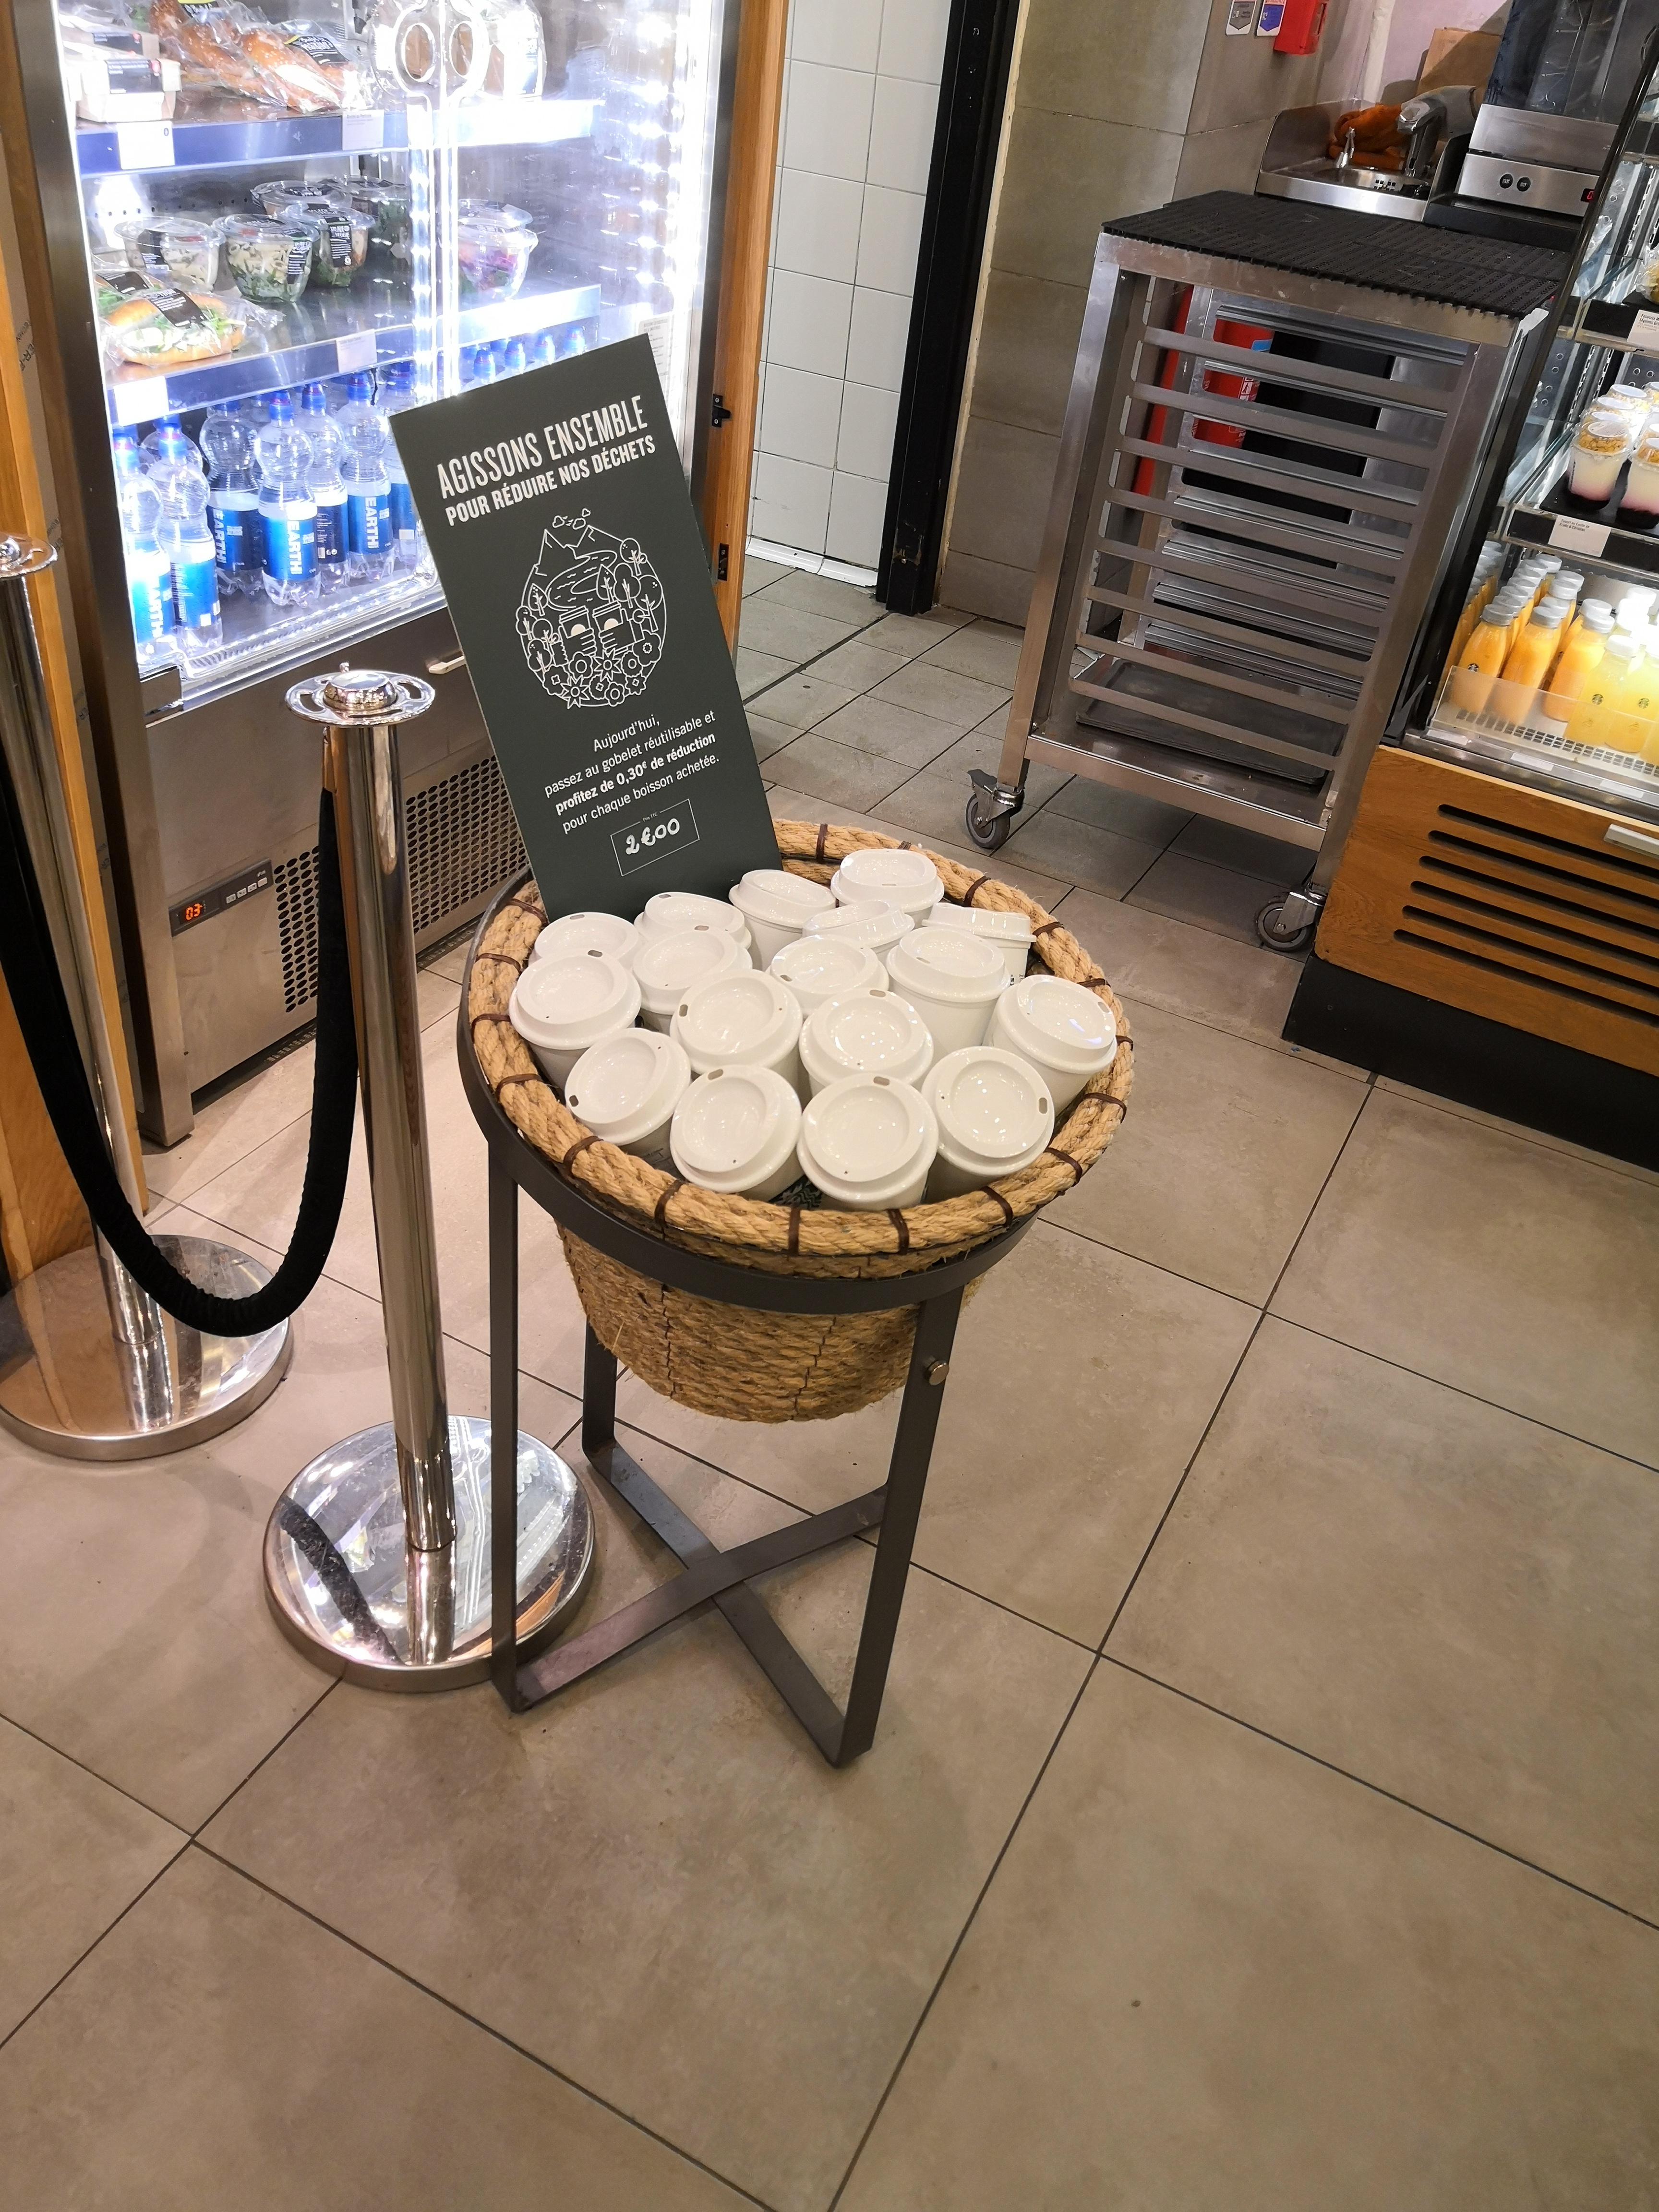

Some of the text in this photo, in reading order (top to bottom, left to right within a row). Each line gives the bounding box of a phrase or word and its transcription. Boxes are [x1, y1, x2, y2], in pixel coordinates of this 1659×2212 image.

[437, 395, 648, 499] AGISSONS ENSEMBLE
[445, 435, 655, 526] POUR RÉDUIRE NOS DÉCHETS
[287, 521, 302, 575] EARTH
[365, 497, 379, 549] EARTH
[545, 710, 715, 798] passez au gobelet réutilisable et
[594, 714, 659, 752] Aujourd'hui,
[556, 734, 715, 816] profitez de 0,30€ de réduction
[563, 755, 719, 834] pour chaque boisson achetée.
